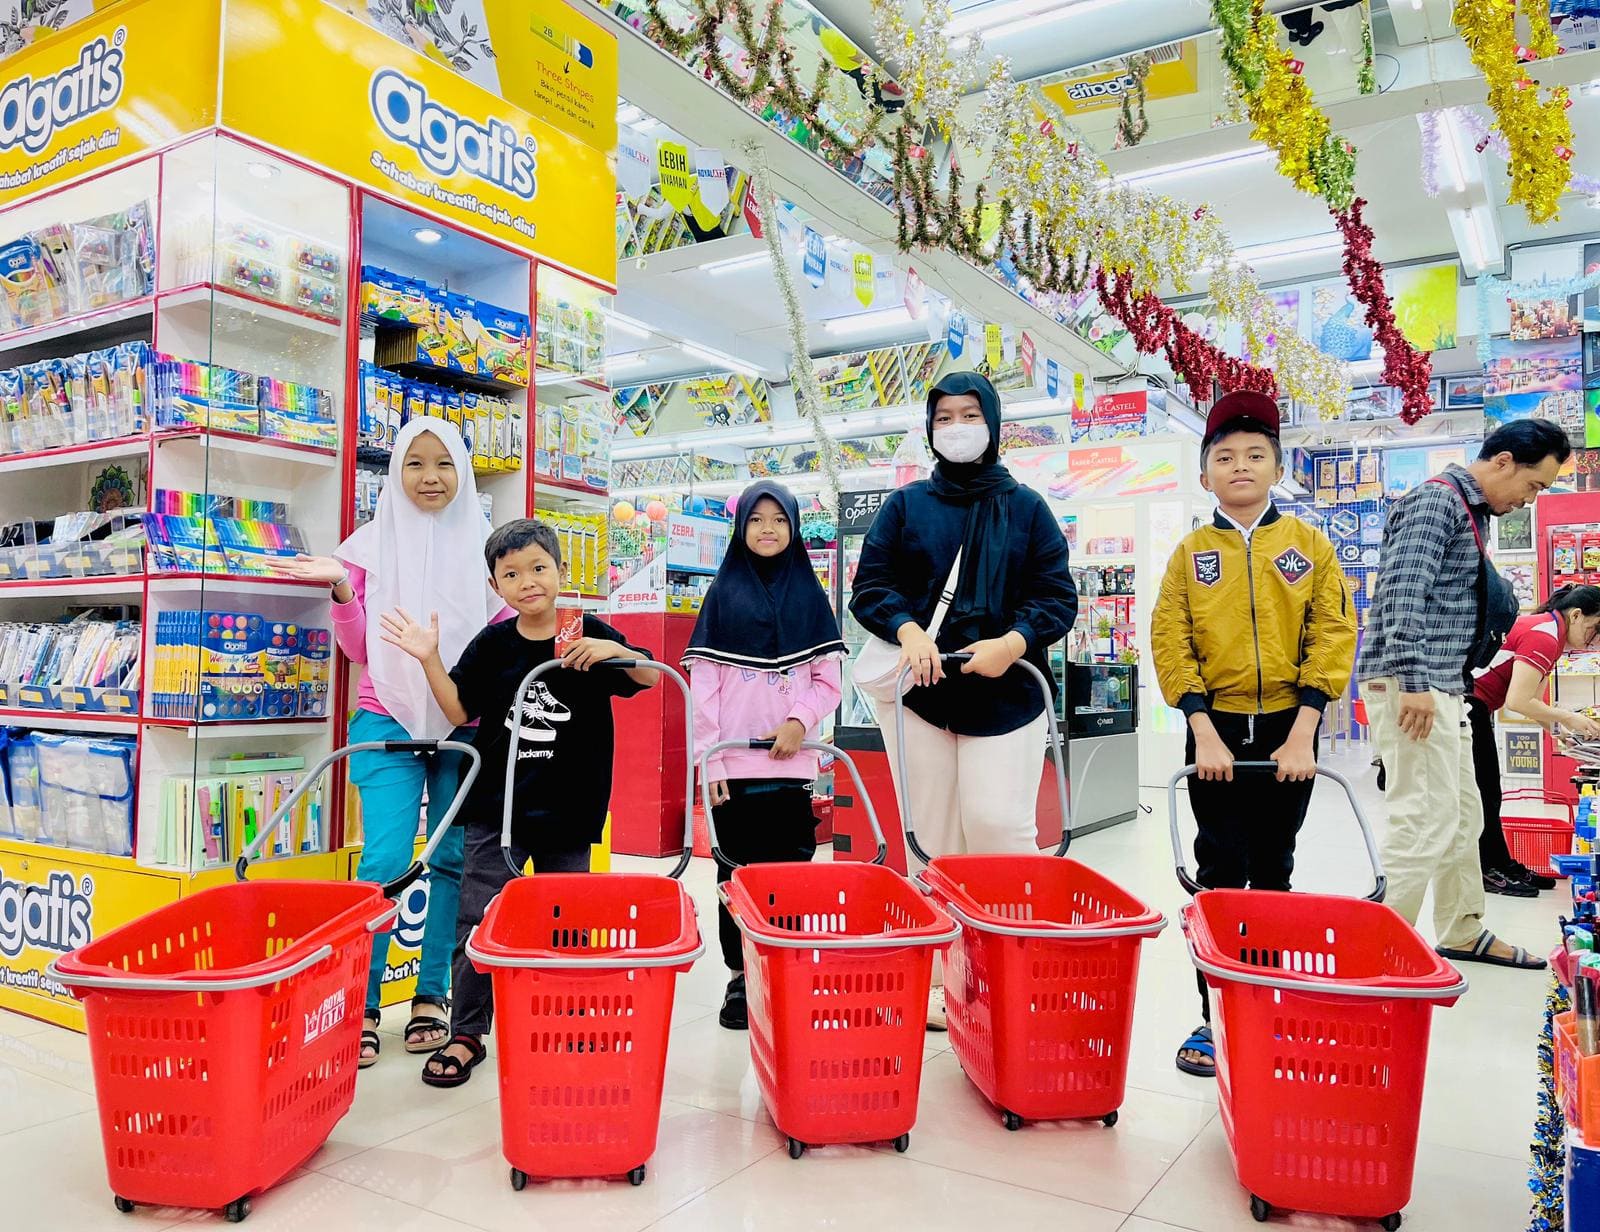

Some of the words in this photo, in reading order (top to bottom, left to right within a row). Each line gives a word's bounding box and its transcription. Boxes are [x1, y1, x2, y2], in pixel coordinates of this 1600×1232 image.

[543, 26, 553, 38] 2B
[536, 60, 562, 84] Three
[565, 78, 594, 103] Stripes
[0, 166, 34, 190] ahabat
[33, 149, 69, 181] kreatif
[68, 137, 97, 164] sejak
[98, 128, 121, 150] dini
[659, 149, 686, 172] LEBIH
[661, 173, 687, 190] NYAMAN
[370, 151, 433, 196] Sahabat
[432, 182, 478, 214] kreatif
[479, 202, 512, 226] sejak
[513, 216, 536, 239] dini
[672, 524, 694, 537] ZEBRA
[618, 593, 658, 602] ZEBRA
[1510, 741, 1537, 750] LATE
[1510, 756, 1538, 768] YOUNG
[0, 873, 92, 957] gatis
[6, 967, 39, 989] kreatif
[322, 988, 346, 1012] ROYAL
[321, 1001, 345, 1033] ATK
